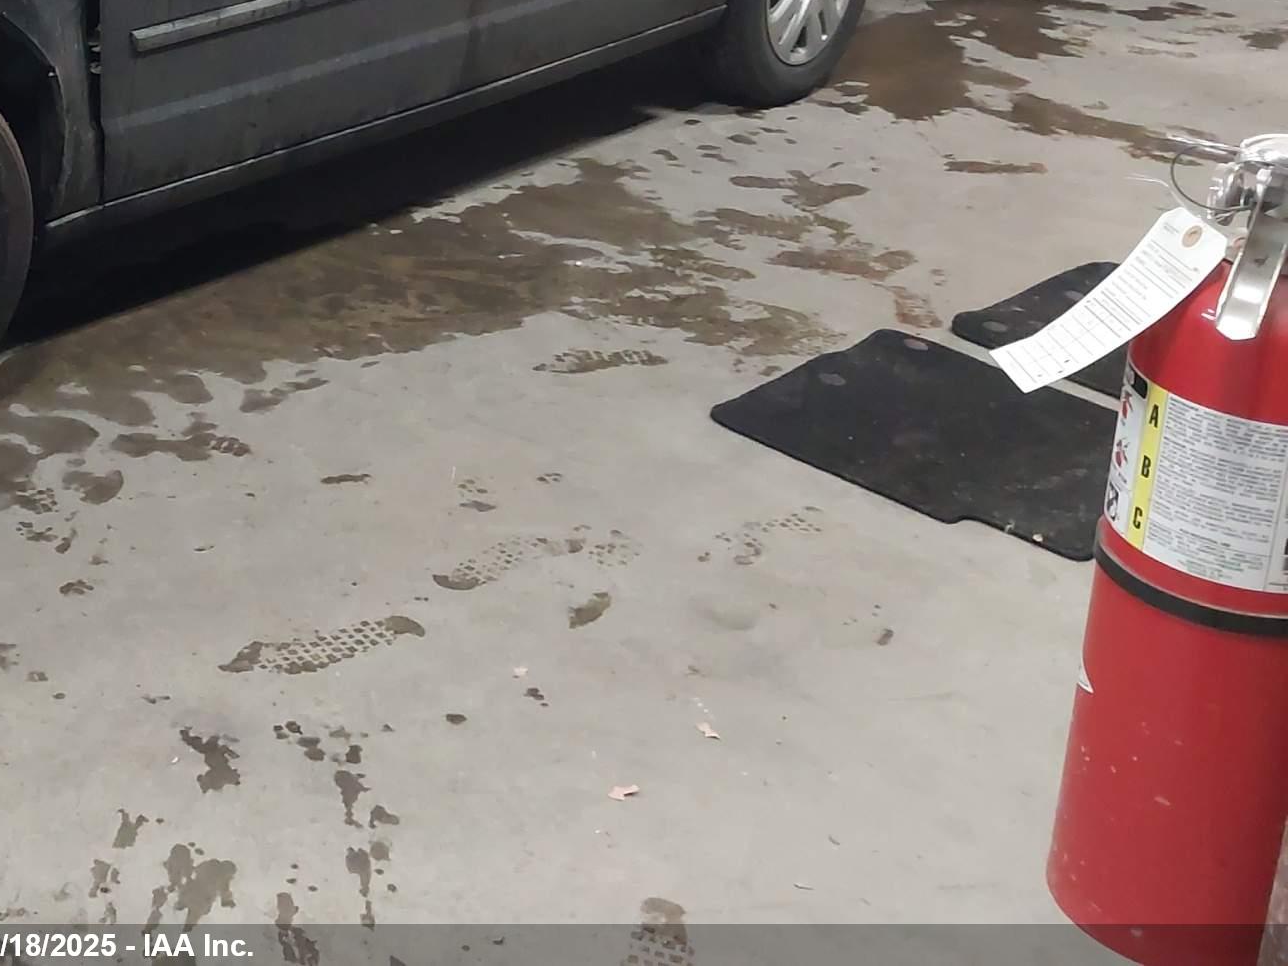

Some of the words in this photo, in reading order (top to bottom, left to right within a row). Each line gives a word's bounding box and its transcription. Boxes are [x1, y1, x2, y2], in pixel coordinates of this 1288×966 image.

[1148, 404, 1160, 428] A
[1140, 455, 1152, 478] B
[1133, 506, 1144, 530] C
